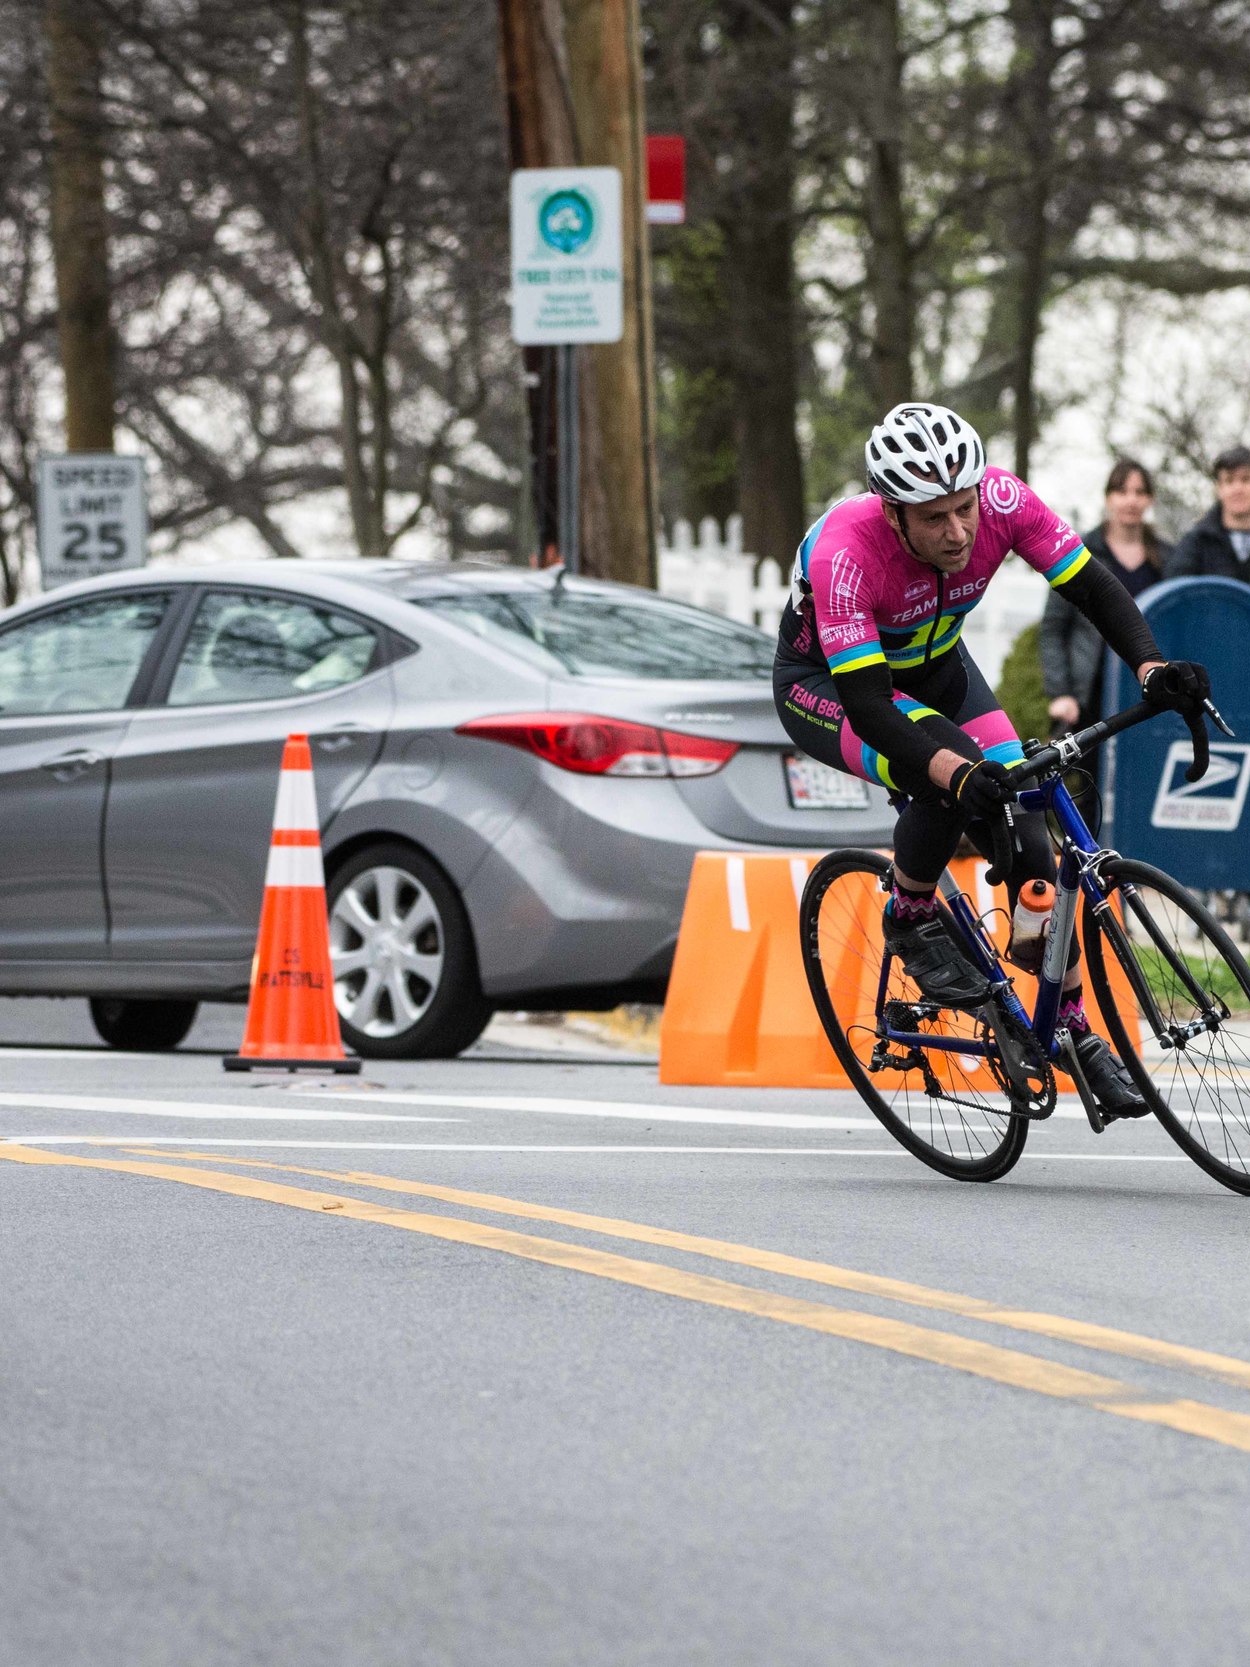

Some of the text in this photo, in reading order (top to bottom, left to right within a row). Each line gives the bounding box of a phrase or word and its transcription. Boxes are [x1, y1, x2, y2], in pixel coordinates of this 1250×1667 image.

[54, 466, 135, 488] SPEED
[62, 521, 127, 561] 25
[892, 596, 939, 624] TEAM
[949, 576, 988, 601] BBC
[842, 630, 866, 646] ART
[789, 683, 844, 720] TEAM BBC
[1003, 802, 1015, 828] RAM
